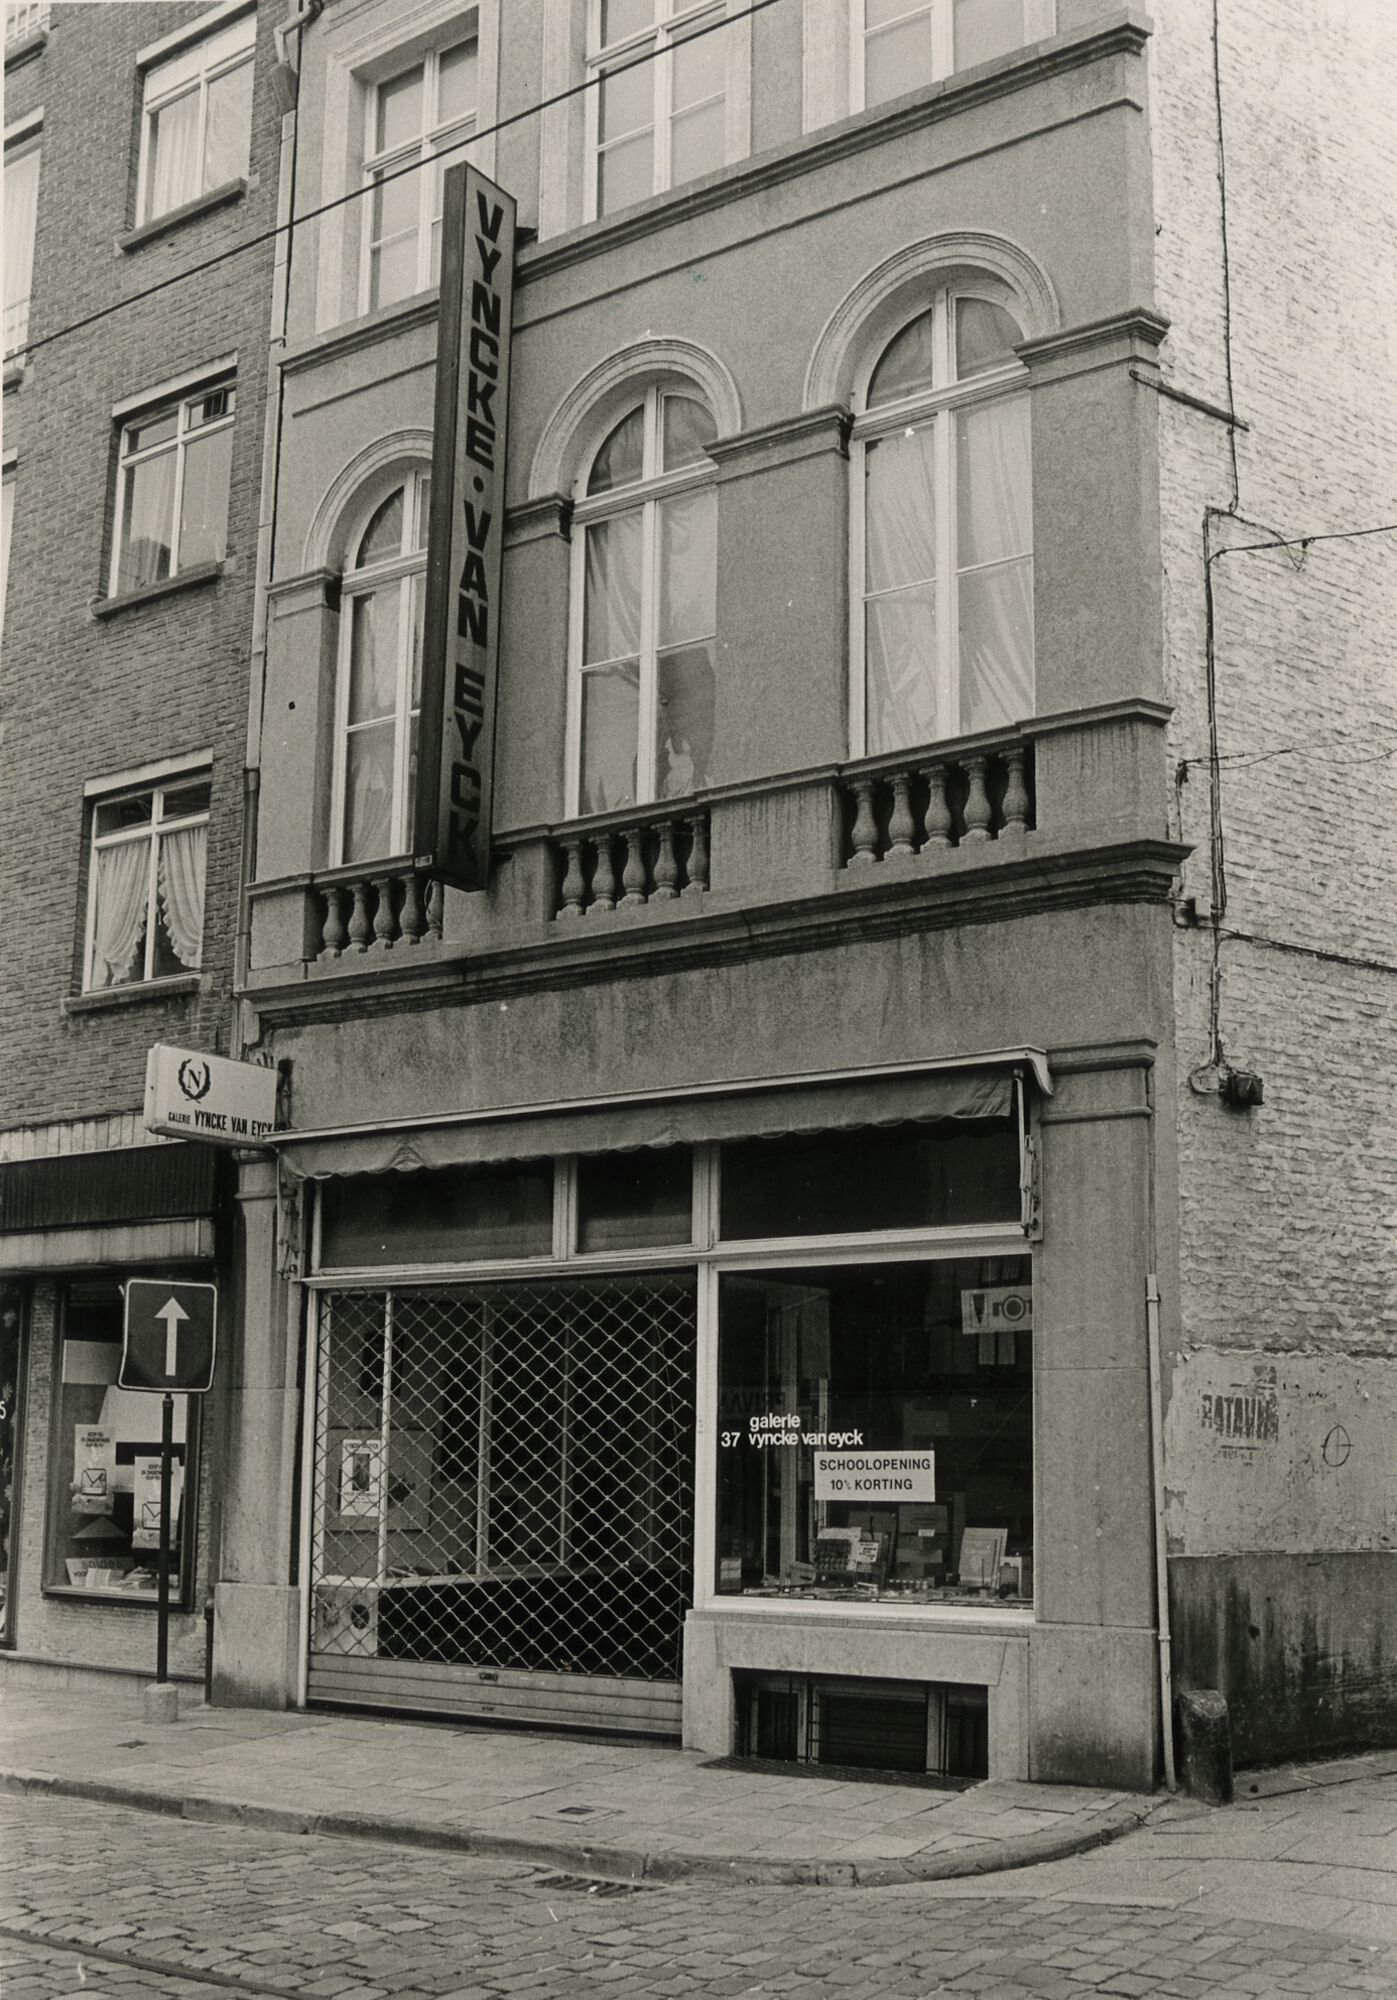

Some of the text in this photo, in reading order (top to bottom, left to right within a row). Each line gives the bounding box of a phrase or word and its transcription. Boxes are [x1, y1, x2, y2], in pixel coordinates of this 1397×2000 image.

[449, 189, 505, 867] VYNCKE VAN EYCK
[188, 1069, 202, 1089] N
[168, 1112, 191, 1125] GALERIE
[195, 1110, 227, 1131] VYNCKE
[231, 1116, 248, 1135] VAN
[749, 1412, 801, 1432] galerie
[721, 1428, 864, 1449] 37 vyncke van eyck
[819, 1458, 931, 1471] SCHOOLOPENING
[830, 1478, 913, 1491] 10% KORTING
